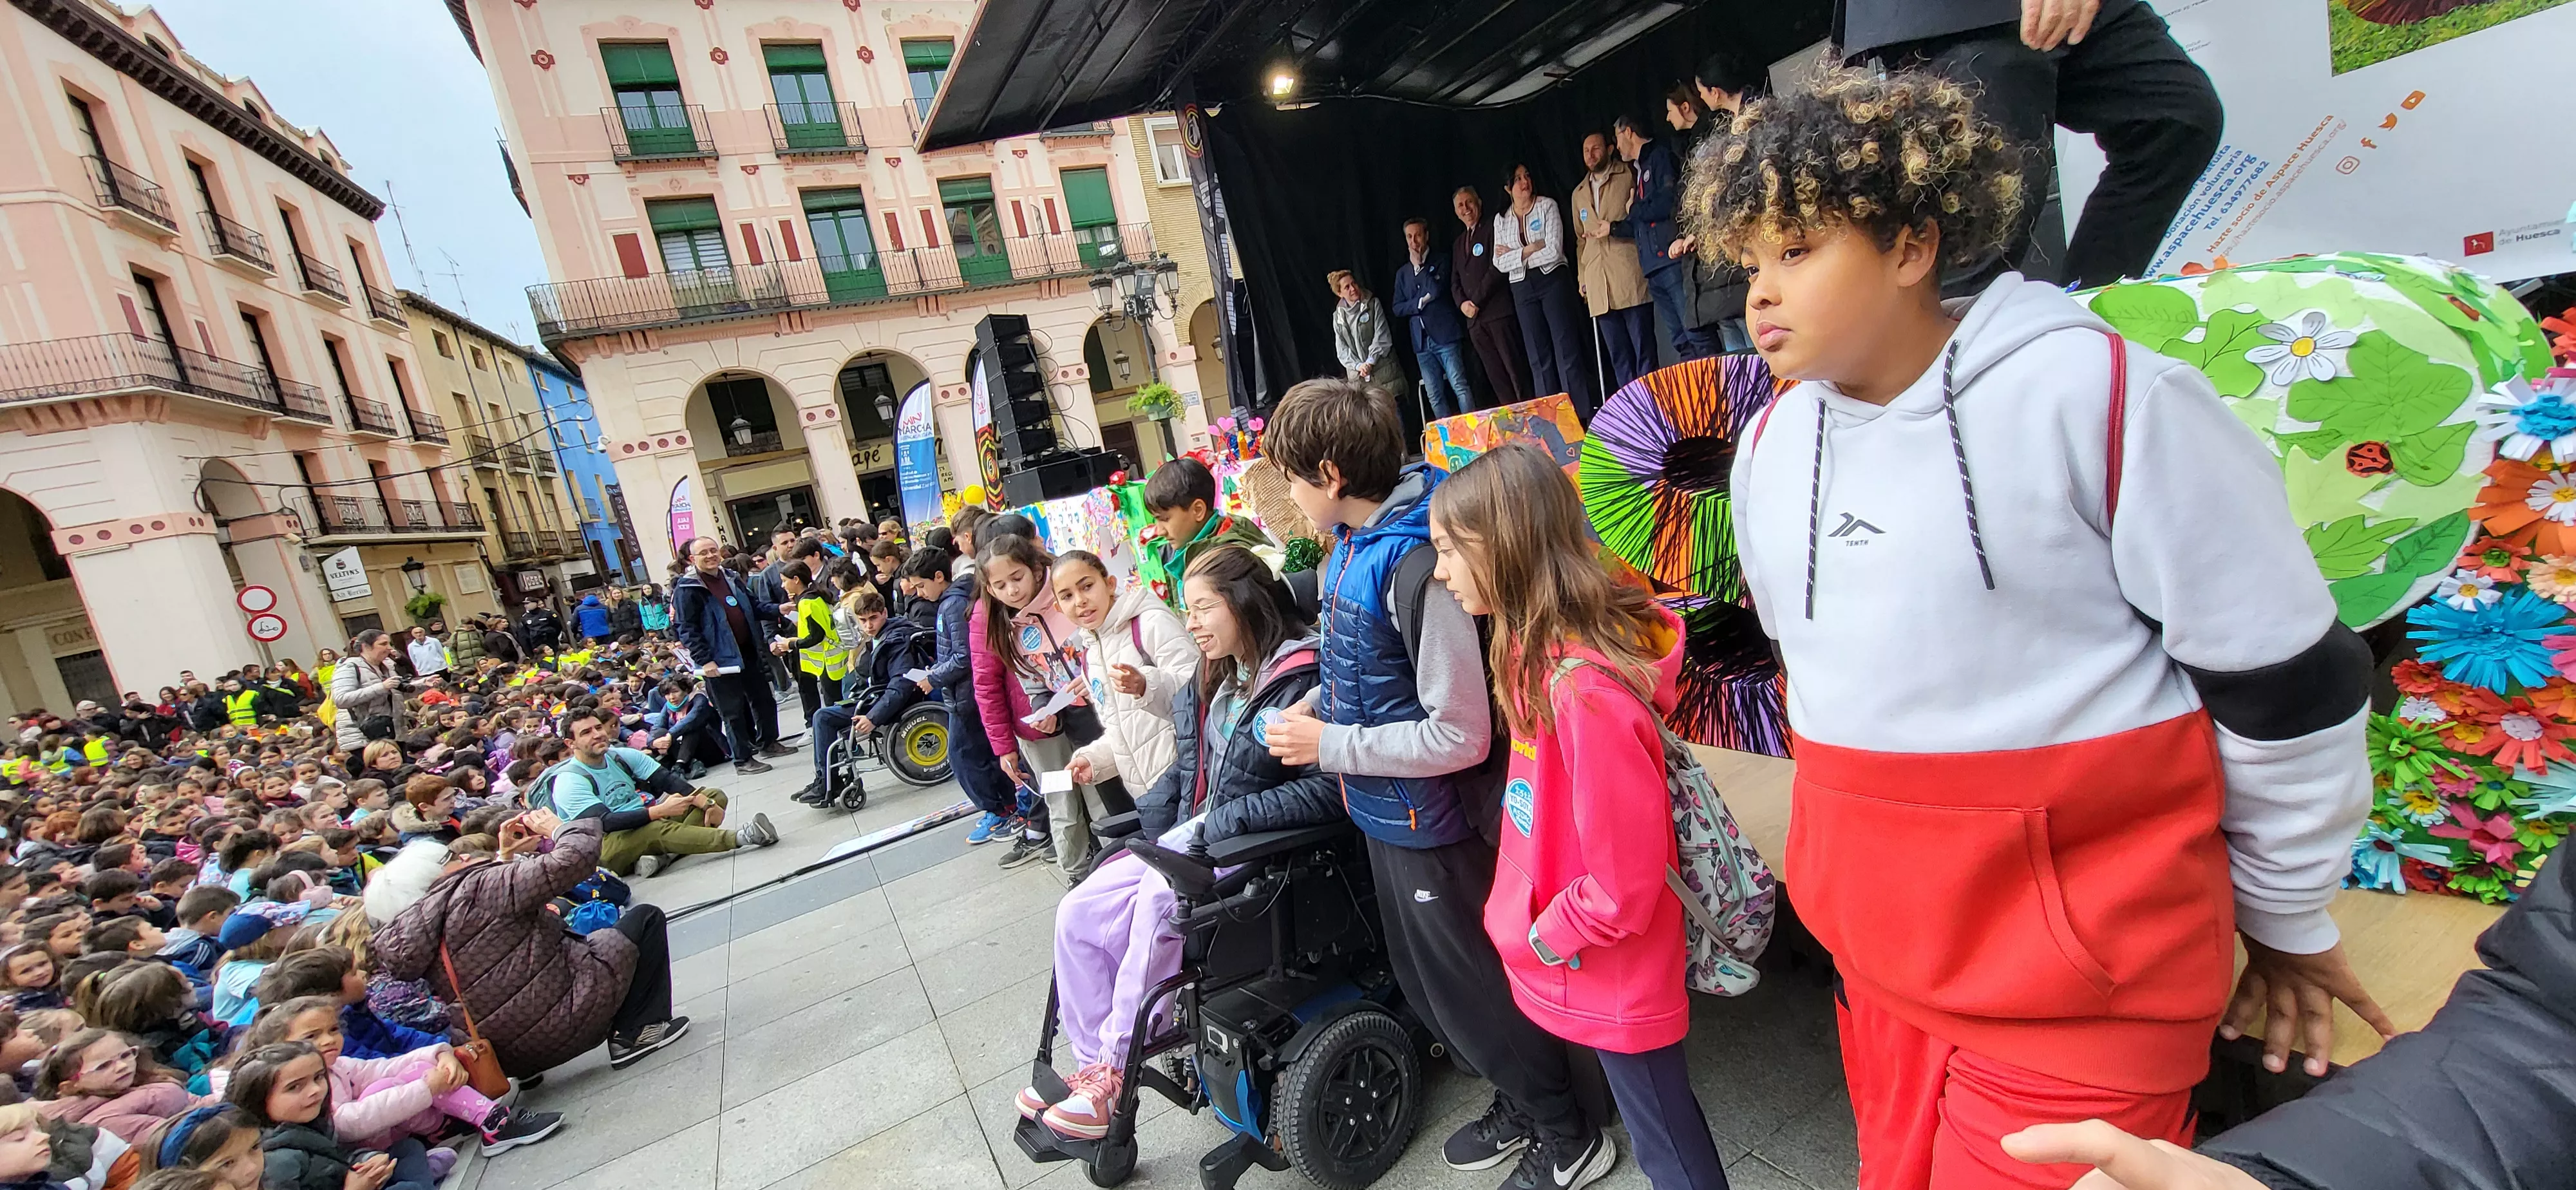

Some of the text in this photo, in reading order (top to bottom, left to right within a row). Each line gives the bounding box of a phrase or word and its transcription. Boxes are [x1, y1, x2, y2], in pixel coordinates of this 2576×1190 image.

[2199, 145, 2231, 183] gatuita
[2199, 149, 2243, 196] voluntaria
[2206, 115, 2334, 252] Hazte socio de Aspace Huesca
[2203, 161, 2269, 231] Tel. 634977682
[2516, 229, 2561, 242] Huesca
[902, 412, 922, 428] MINI
[329, 569, 360, 579] VELTINS
[901, 716, 927, 739] MIGUEL
[1416, 889, 1430, 898] NIKE
